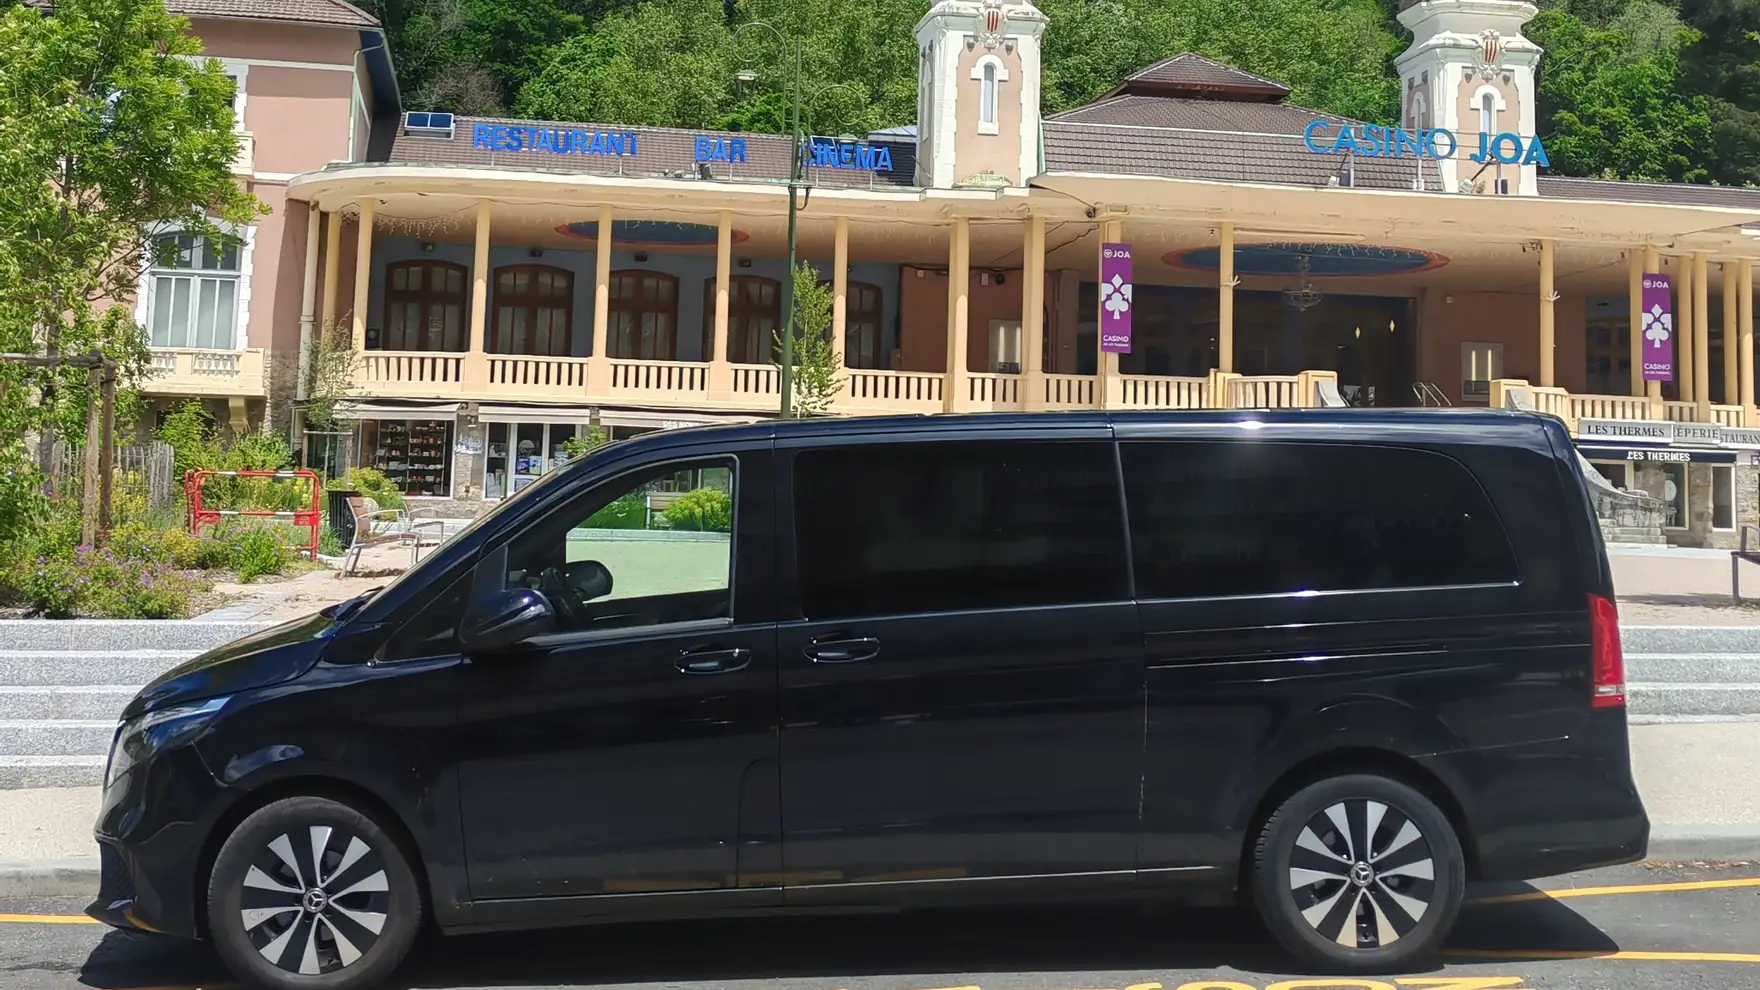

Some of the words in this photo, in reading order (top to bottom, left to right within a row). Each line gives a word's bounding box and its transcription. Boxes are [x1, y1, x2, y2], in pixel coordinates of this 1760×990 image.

[473, 122, 639, 156] RESTAURANT
[1304, 120, 1457, 160] CASINO
[1470, 131, 1551, 167] JOA
[694, 135, 747, 162] BAR
[1112, 250, 1131, 259] JOA
[1651, 280, 1669, 289] JOA
[1103, 334, 1129, 342] CASINO
[1587, 424, 1608, 435] LES
[1611, 425, 1665, 437] THERMES
[1673, 425, 1718, 439] ÊPERIE
[1627, 450, 1645, 460] LES
[1647, 451, 1691, 462] THERMES
